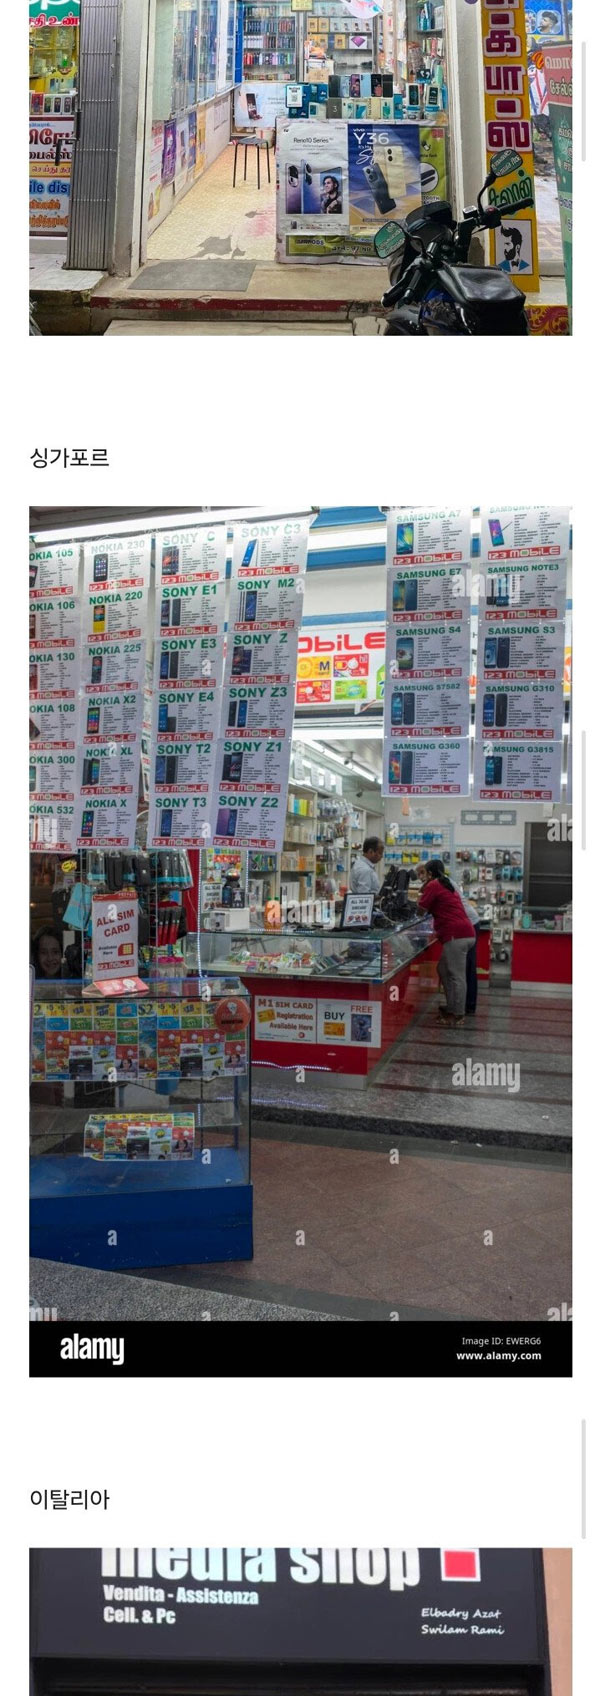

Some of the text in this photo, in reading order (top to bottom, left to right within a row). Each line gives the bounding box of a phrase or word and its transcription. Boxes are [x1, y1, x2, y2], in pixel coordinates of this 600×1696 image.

[353, 133, 389, 145] Y36
[396, 568, 461, 579] SAMSUNG E7
[162, 585, 217, 598] SONY E1
[89, 591, 142, 605] NOKIA 220
[229, 687, 287, 698] SONY Z3
[437, 742, 460, 750] G360
[324, 1012, 344, 1020] BUY
[104, 1585, 259, 1605] Vendita Assistenza
